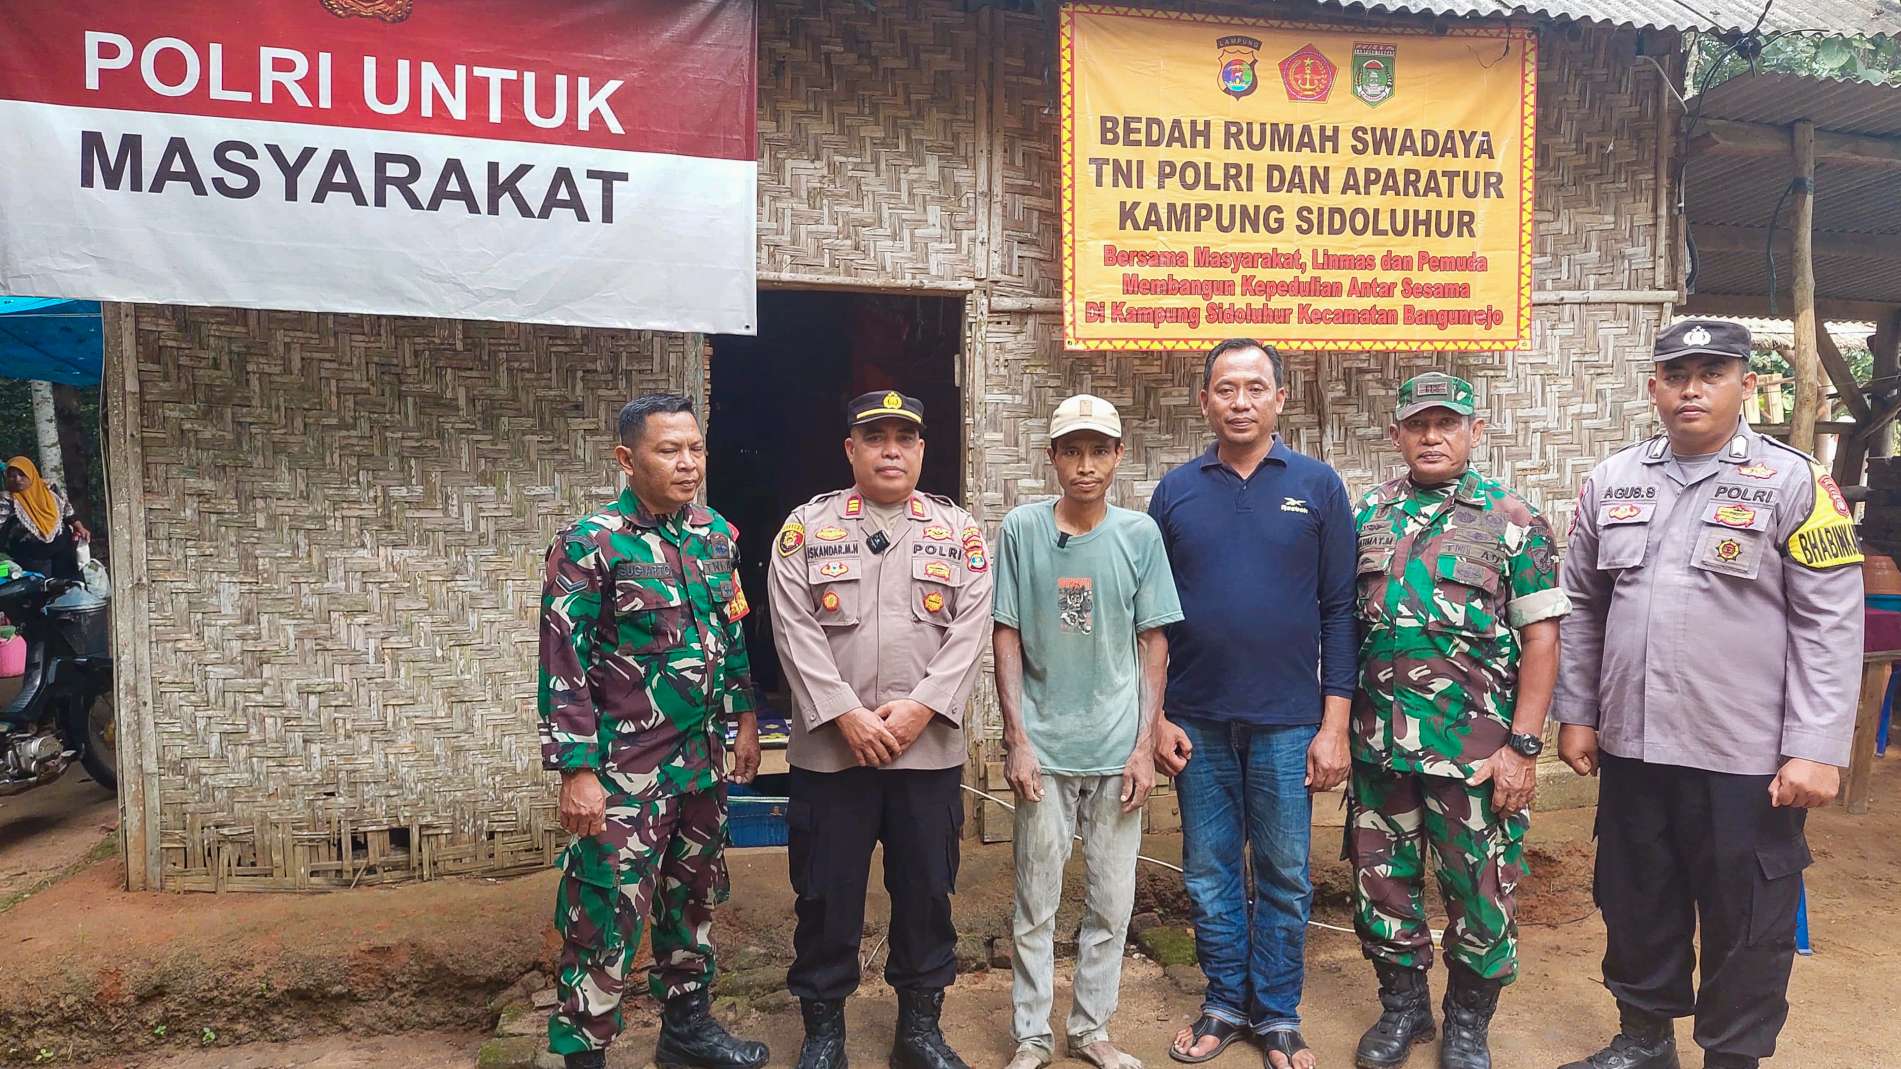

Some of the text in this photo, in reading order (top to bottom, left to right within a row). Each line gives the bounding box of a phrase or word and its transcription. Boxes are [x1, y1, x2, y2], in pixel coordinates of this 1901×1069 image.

[83, 30, 626, 135] POLRI UNTUK
[1100, 115, 1495, 159] BEDAH RUMAH SWADAYA
[80, 130, 629, 224] MASYARAKAT
[1089, 157, 1505, 199] TNI POLRI DAN APARATUR
[1118, 200, 1476, 238] KAMPUNG SIDOLUHUR
[1103, 244, 1488, 274] Bersama Masyarakat, Linmas dan Pemuda
[1122, 273, 1471, 301] Membangun Kepedulian Antar Sesama
[1085, 301, 1504, 331] Di Kampung Sidoluhur Kecamatan Bangunrejo
[1604, 486, 1656, 499] AGUS.S
[1714, 486, 1774, 503] POLRI
[913, 543, 962, 561] POLRI
